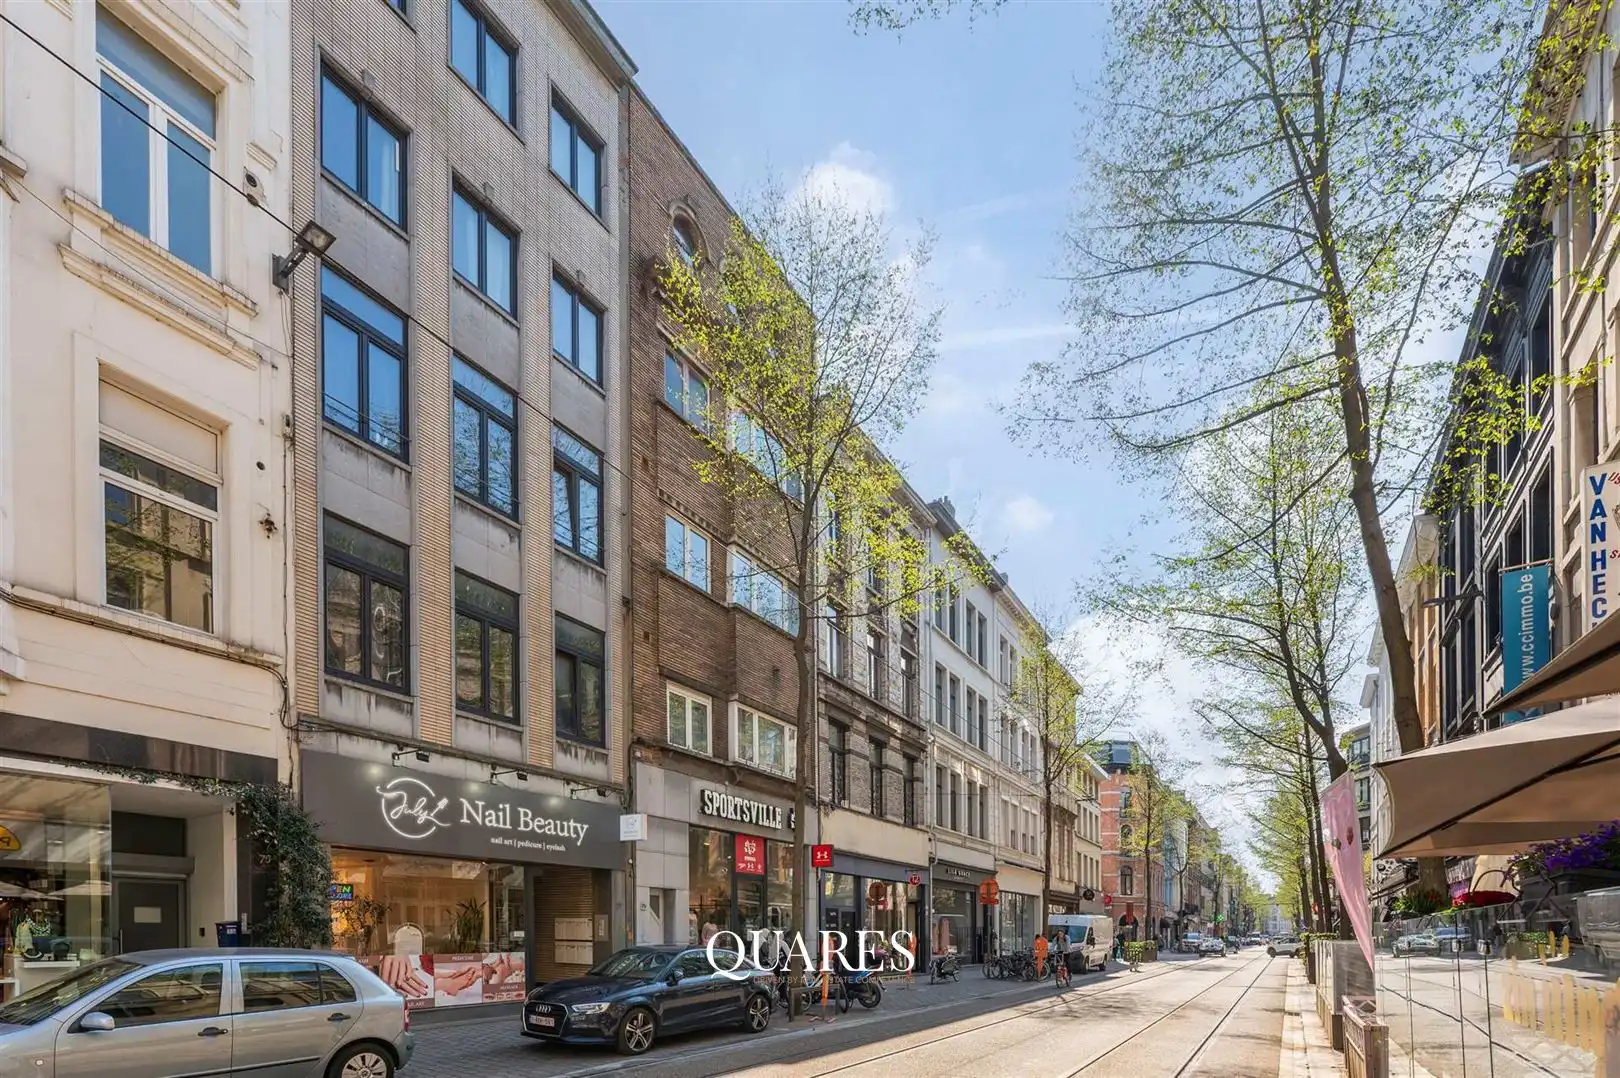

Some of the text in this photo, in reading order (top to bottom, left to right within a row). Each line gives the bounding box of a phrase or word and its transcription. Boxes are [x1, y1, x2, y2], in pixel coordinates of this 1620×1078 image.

[1589, 473, 1608, 629] VAN HEC
[1517, 573, 1535, 684] ww.ccimmo.be
[376, 785, 451, 826] July
[460, 798, 590, 847] Nail Beauty
[703, 789, 782, 830] SPORTSVILLE
[490, 836, 503, 845] nail
[517, 840, 542, 849] pedicure
[546, 844, 567, 852] eyelash
